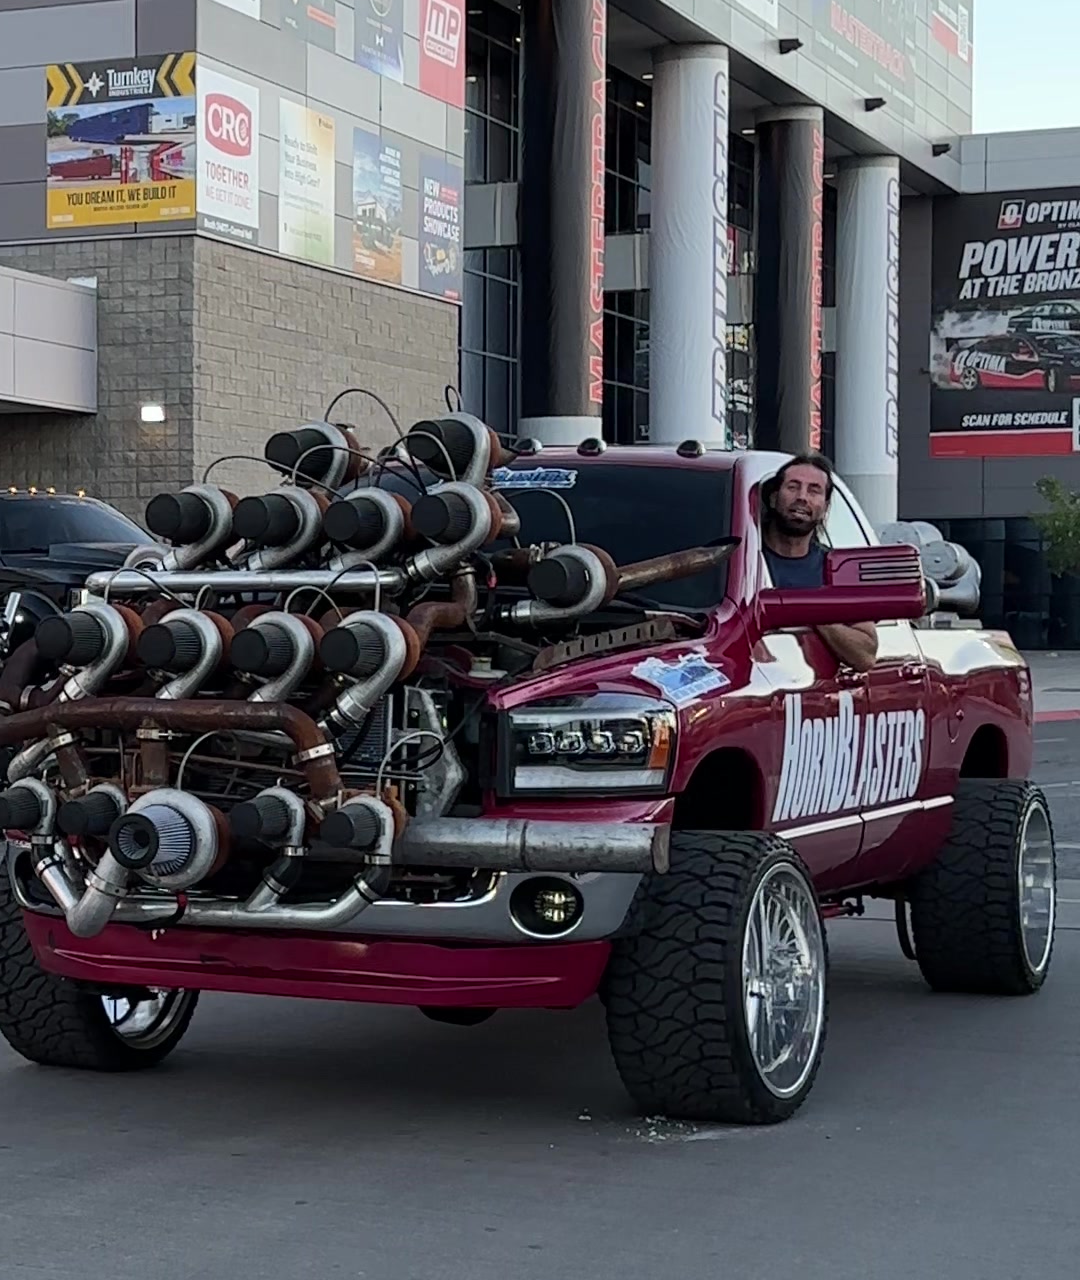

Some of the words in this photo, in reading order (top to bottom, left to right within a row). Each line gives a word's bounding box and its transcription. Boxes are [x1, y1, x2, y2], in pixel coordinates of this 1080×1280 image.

[107, 66, 156, 93] Turnkey
[108, 86, 149, 97] INDUSTRIES
[207, 102, 250, 147] CRC
[67, 191, 83, 206] YOU
[85, 188, 115, 204] DREAM
[127, 188, 141, 201] WE
[143, 185, 167, 200] BUILD
[423, 176, 440, 198] NEW
[423, 197, 459, 224] PRODUCTS
[423, 216, 460, 243] SHOWCASE
[959, 231, 1080, 279] POWER
[959, 277, 984, 300] AT
[986, 273, 1022, 297] THE
[961, 414, 991, 429] SCAN
[992, 413, 1013, 427] FOR
[1013, 411, 1068, 426] SCHEDULE
